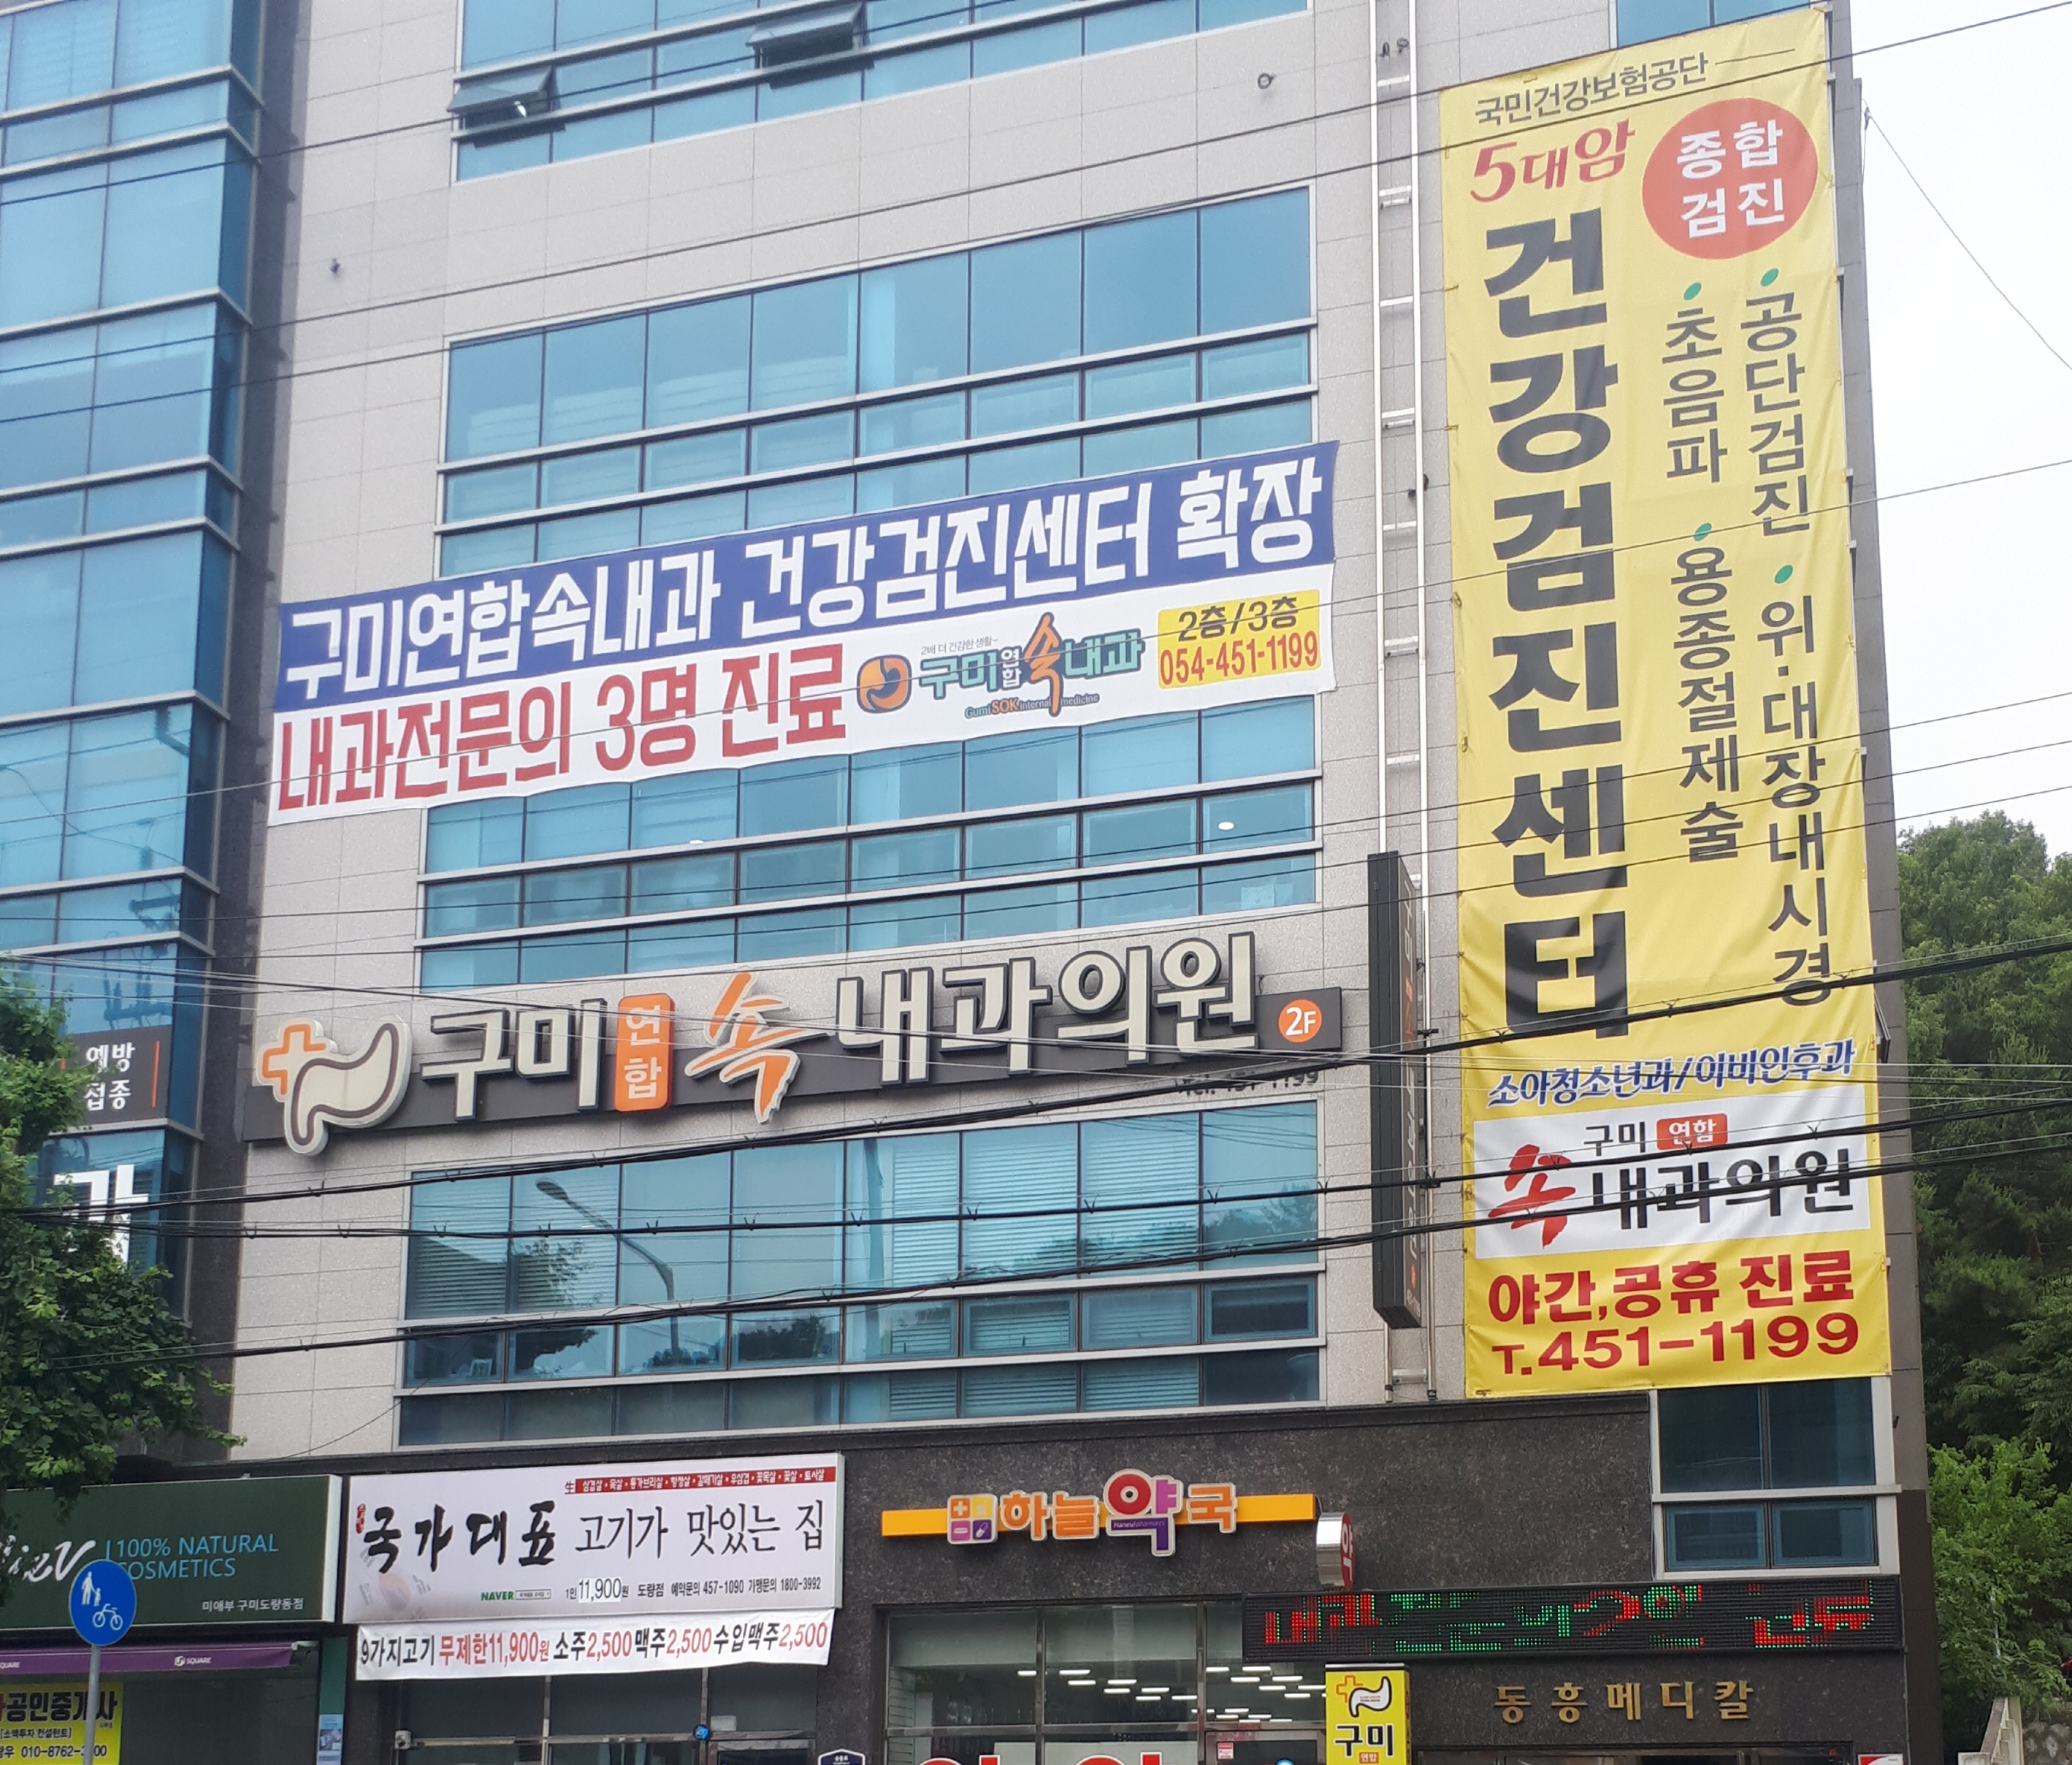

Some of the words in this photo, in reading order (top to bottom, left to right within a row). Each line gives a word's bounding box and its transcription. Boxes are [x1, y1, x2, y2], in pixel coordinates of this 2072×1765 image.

[1475, 52, 1709, 126] 국민건강보험공단
[1470, 118, 1635, 203] 5대암
[1676, 119, 1783, 179] 종합
[1681, 178, 1785, 238] 검진
[1662, 308, 1727, 484] 초음파
[1740, 293, 1810, 536] 공단검진
[286, 550, 721, 699] 구미연합속내과
[742, 483, 1152, 639] 건강검진센터
[1177, 457, 1322, 570] 확장
[921, 644, 936, 655] 2배
[938, 643, 947, 654] 더
[949, 638, 974, 652] 건강한
[1484, 207, 1628, 1039] 건강검진센터
[920, 650, 999, 699] 구미
[1001, 647, 1022, 688] 연합
[1159, 631, 1319, 687] 054-451-1199
[278, 682, 570, 812] 내과전문의
[596, 663, 696, 772] 3명
[722, 643, 846, 758] 진료
[1060, 693, 1100, 706] medicine
[1671, 546, 1743, 864] 용종절제술
[420, 998, 607, 1121] 구미
[624, 1004, 661, 1101] 연합
[684, 966, 830, 1125] 속
[836, 931, 1258, 1085] 내과의원
[1285, 1006, 1318, 1036] 2F
[85, 1042, 135, 1073] 예방
[84, 1079, 131, 1111] 접종
[1583, 1121, 1645, 1157] 구미
[1668, 1119, 1717, 1145] 연합
[1591, 1148, 1854, 1230] 내과의원
[1488, 1260, 1720, 1325] 야간,공휴
[1740, 1249, 1854, 1309] 진료
[364, 1501, 556, 1574] 국가대표
[575, 1505, 668, 1560] 고기가
[687, 1503, 781, 1557] 맛있는
[795, 1499, 823, 1551] 집
[1000, 1468, 1237, 1557] 하늘약국
[116, 1537, 170, 1558] 100%
[178, 1533, 278, 1556] NATURAL
[202, 1600, 234, 1612] 미애부
[237, 1597, 304, 1612] 구미도량동점
[481, 1591, 514, 1601] NAVER
[638, 1582, 664, 1598] 도량점
[671, 1581, 700, 1597] 예약문의
[703, 1579, 744, 1595] 457-1090
[749, 1577, 777, 1594] 가맹문의
[781, 1576, 821, 1591] 1800-3992
[186, 1656, 212, 1665] SQUARE
[361, 1635, 435, 1667] 9가지고기
[1494, 1679, 1754, 1726] 동흥메디칼
[1334, 1723, 1394, 1758] 구미
